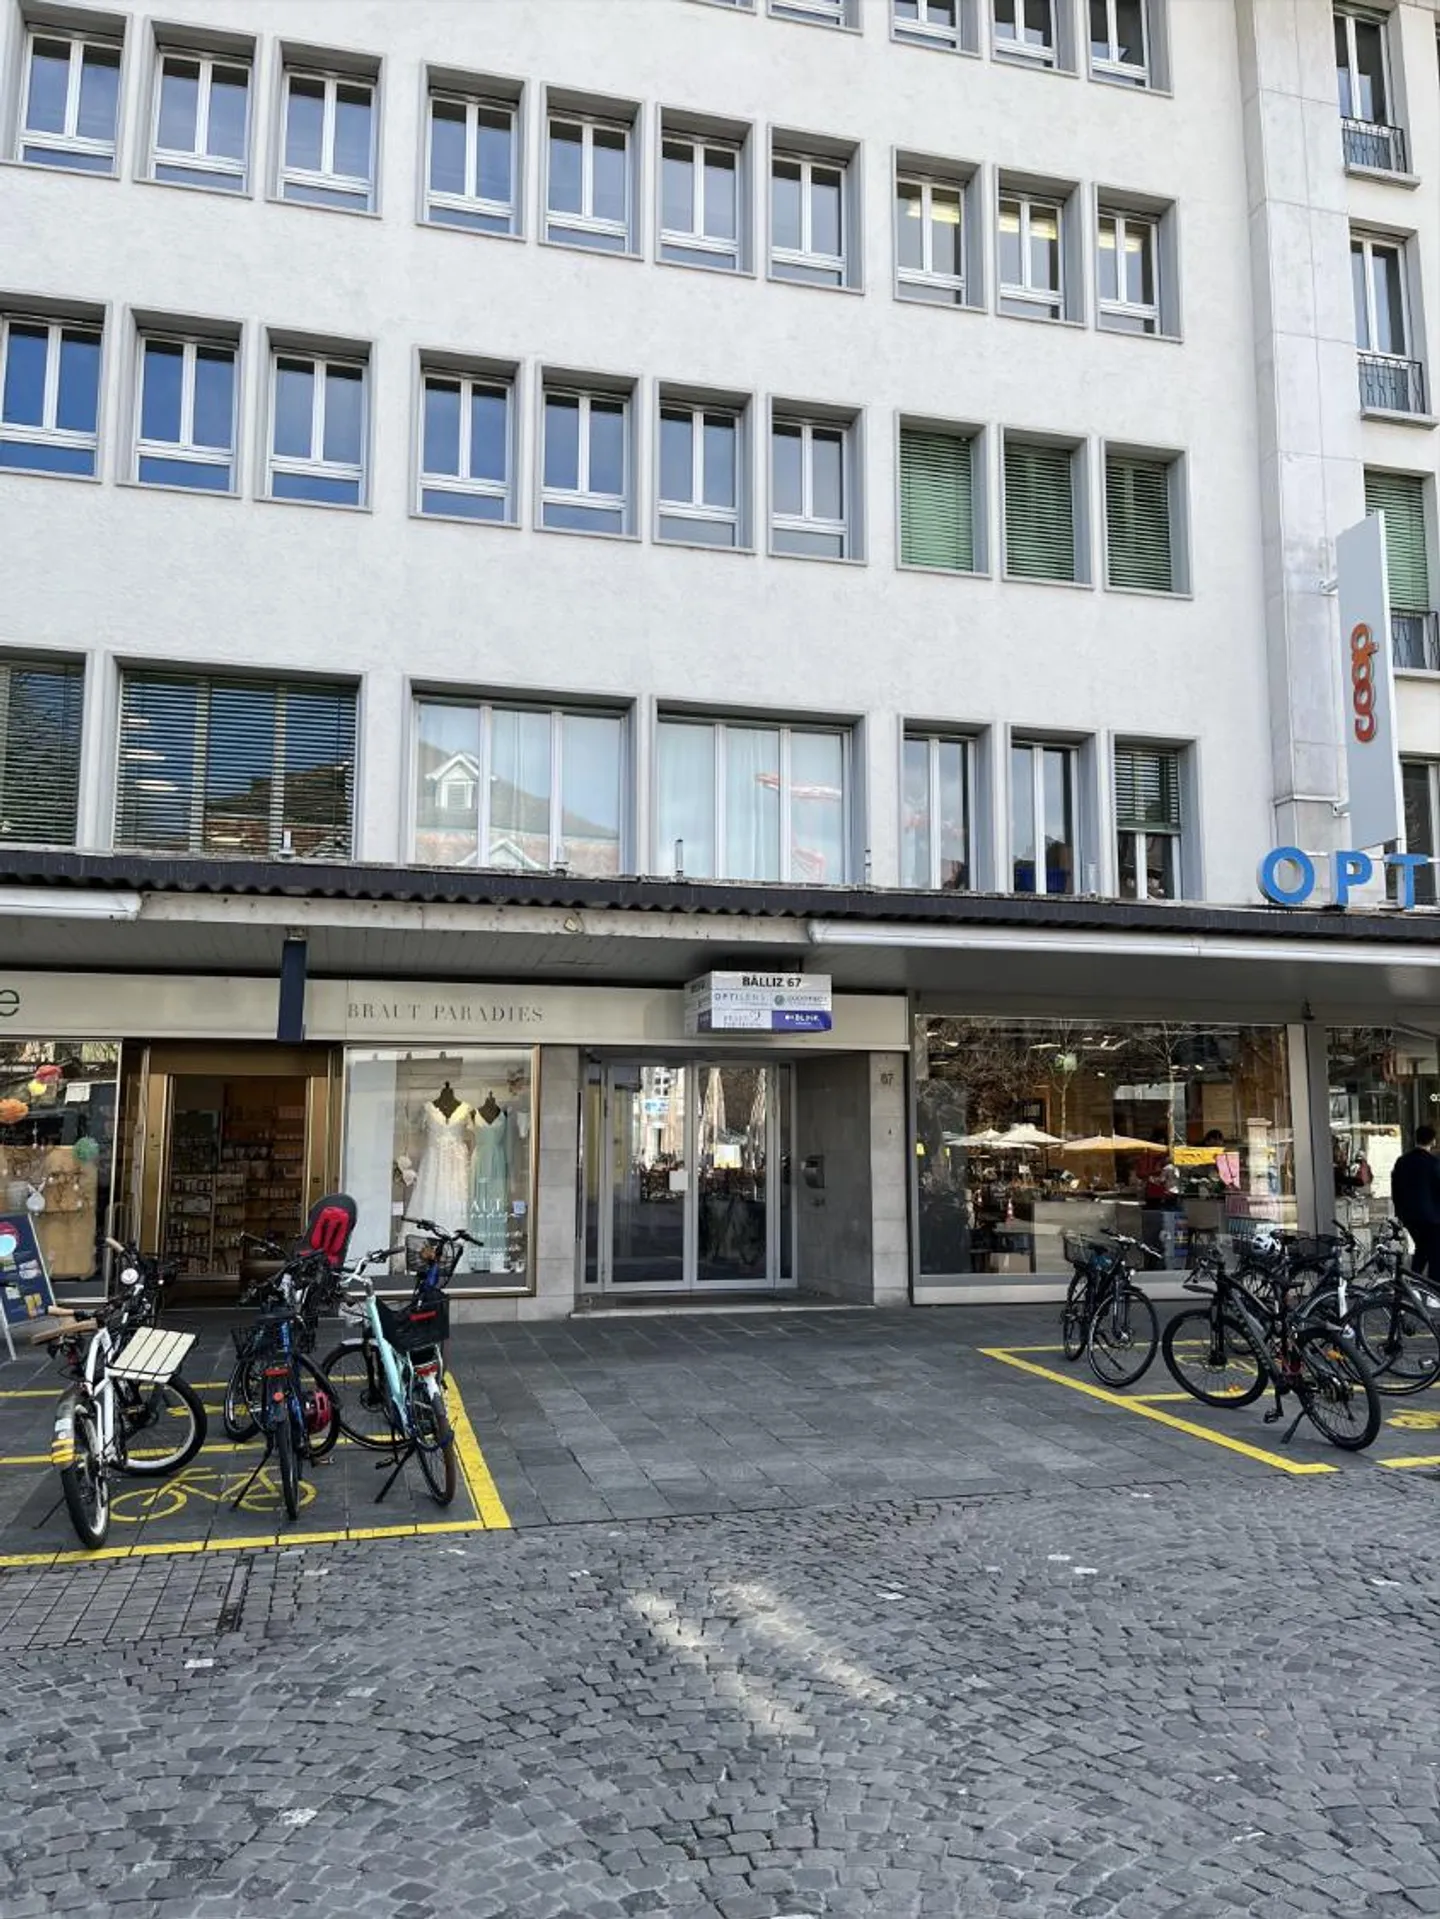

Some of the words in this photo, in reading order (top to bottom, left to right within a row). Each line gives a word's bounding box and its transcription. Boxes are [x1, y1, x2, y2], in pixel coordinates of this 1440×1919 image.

[1351, 622, 1380, 744] coop
[1257, 846, 1430, 910] OPT
[787, 977, 802, 987] 67
[348, 1003, 420, 1019] BRAUT
[433, 1006, 545, 1022] PARADIES
